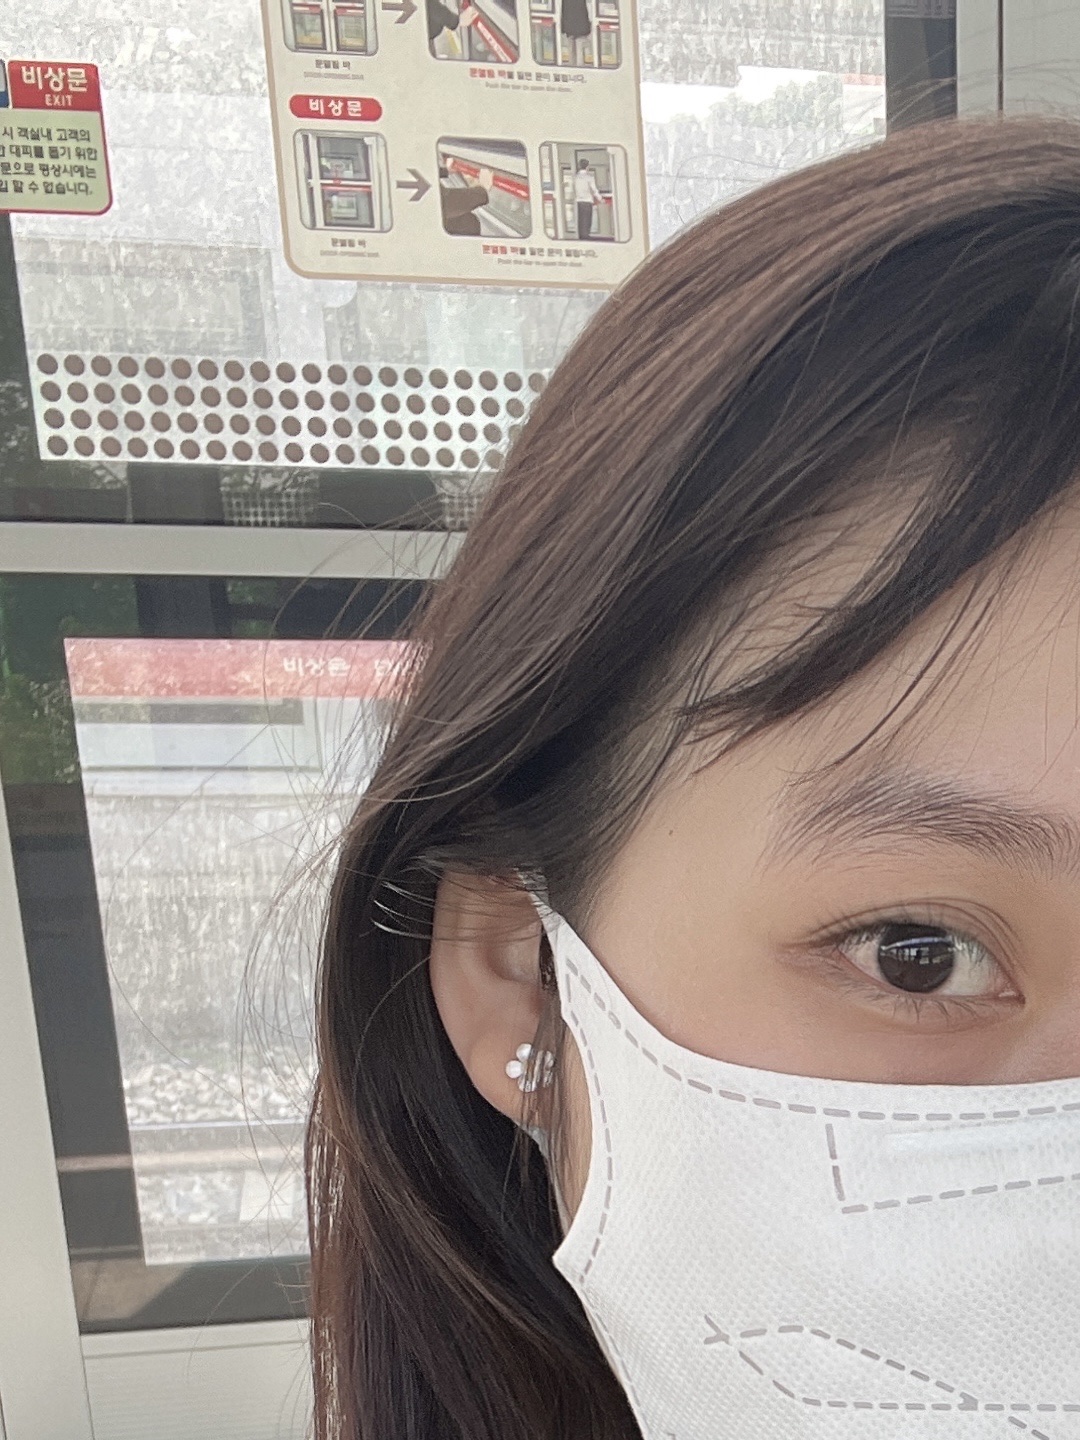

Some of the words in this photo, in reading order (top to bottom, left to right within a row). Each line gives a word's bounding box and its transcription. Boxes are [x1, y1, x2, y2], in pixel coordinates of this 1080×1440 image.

[21, 66, 88, 92] 비상문
[45, 94, 73, 106] EXIT
[308, 98, 362, 117] 비상문
[2, 127, 14, 139] 시
[17, 127, 52, 141] 객실내
[56, 129, 91, 143] 고객의
[10, 145, 44, 158] 대피를
[75, 147, 97, 161] 위한
[1, 162, 35, 175] 문으로
[39, 163, 97, 178] 평상시에는
[13, 180, 24, 193] 할
[28, 181, 39, 194] 수
[43, 182, 93, 196] 없습니다.
